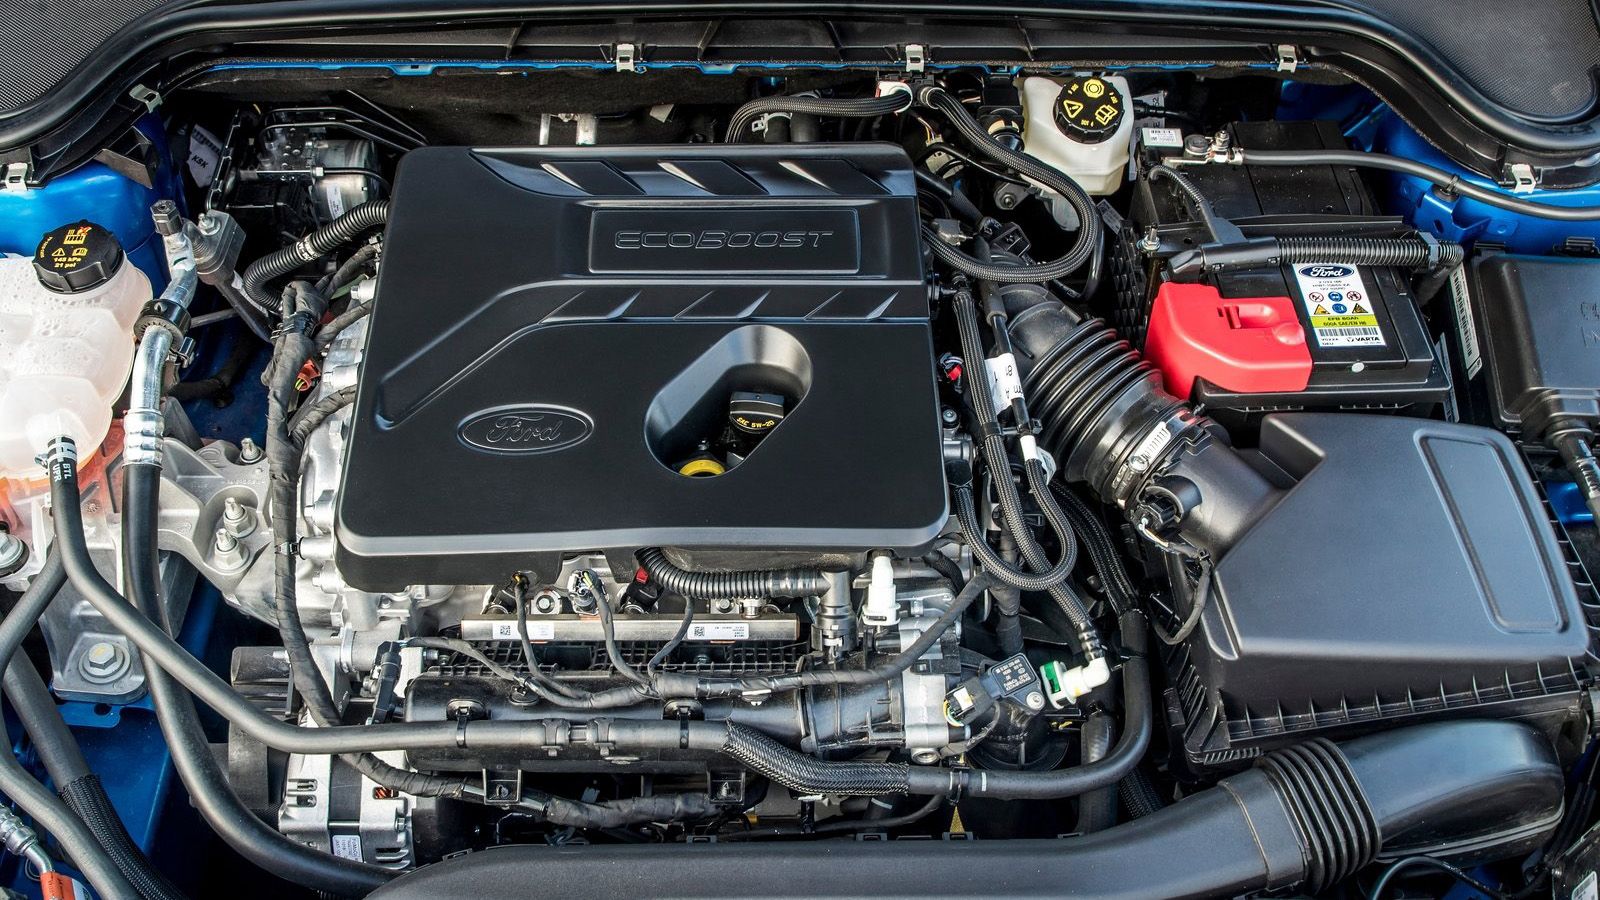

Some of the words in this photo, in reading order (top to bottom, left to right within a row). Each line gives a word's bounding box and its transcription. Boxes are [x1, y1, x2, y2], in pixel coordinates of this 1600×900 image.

[1310, 266, 1344, 276] Ford
[486, 416, 563, 442] Ford
[737, 417, 750, 426] SAE
[752, 420, 774, 428] 5W-20
[52, 464, 62, 482] UPR
[63, 464, 72, 479] BTL
